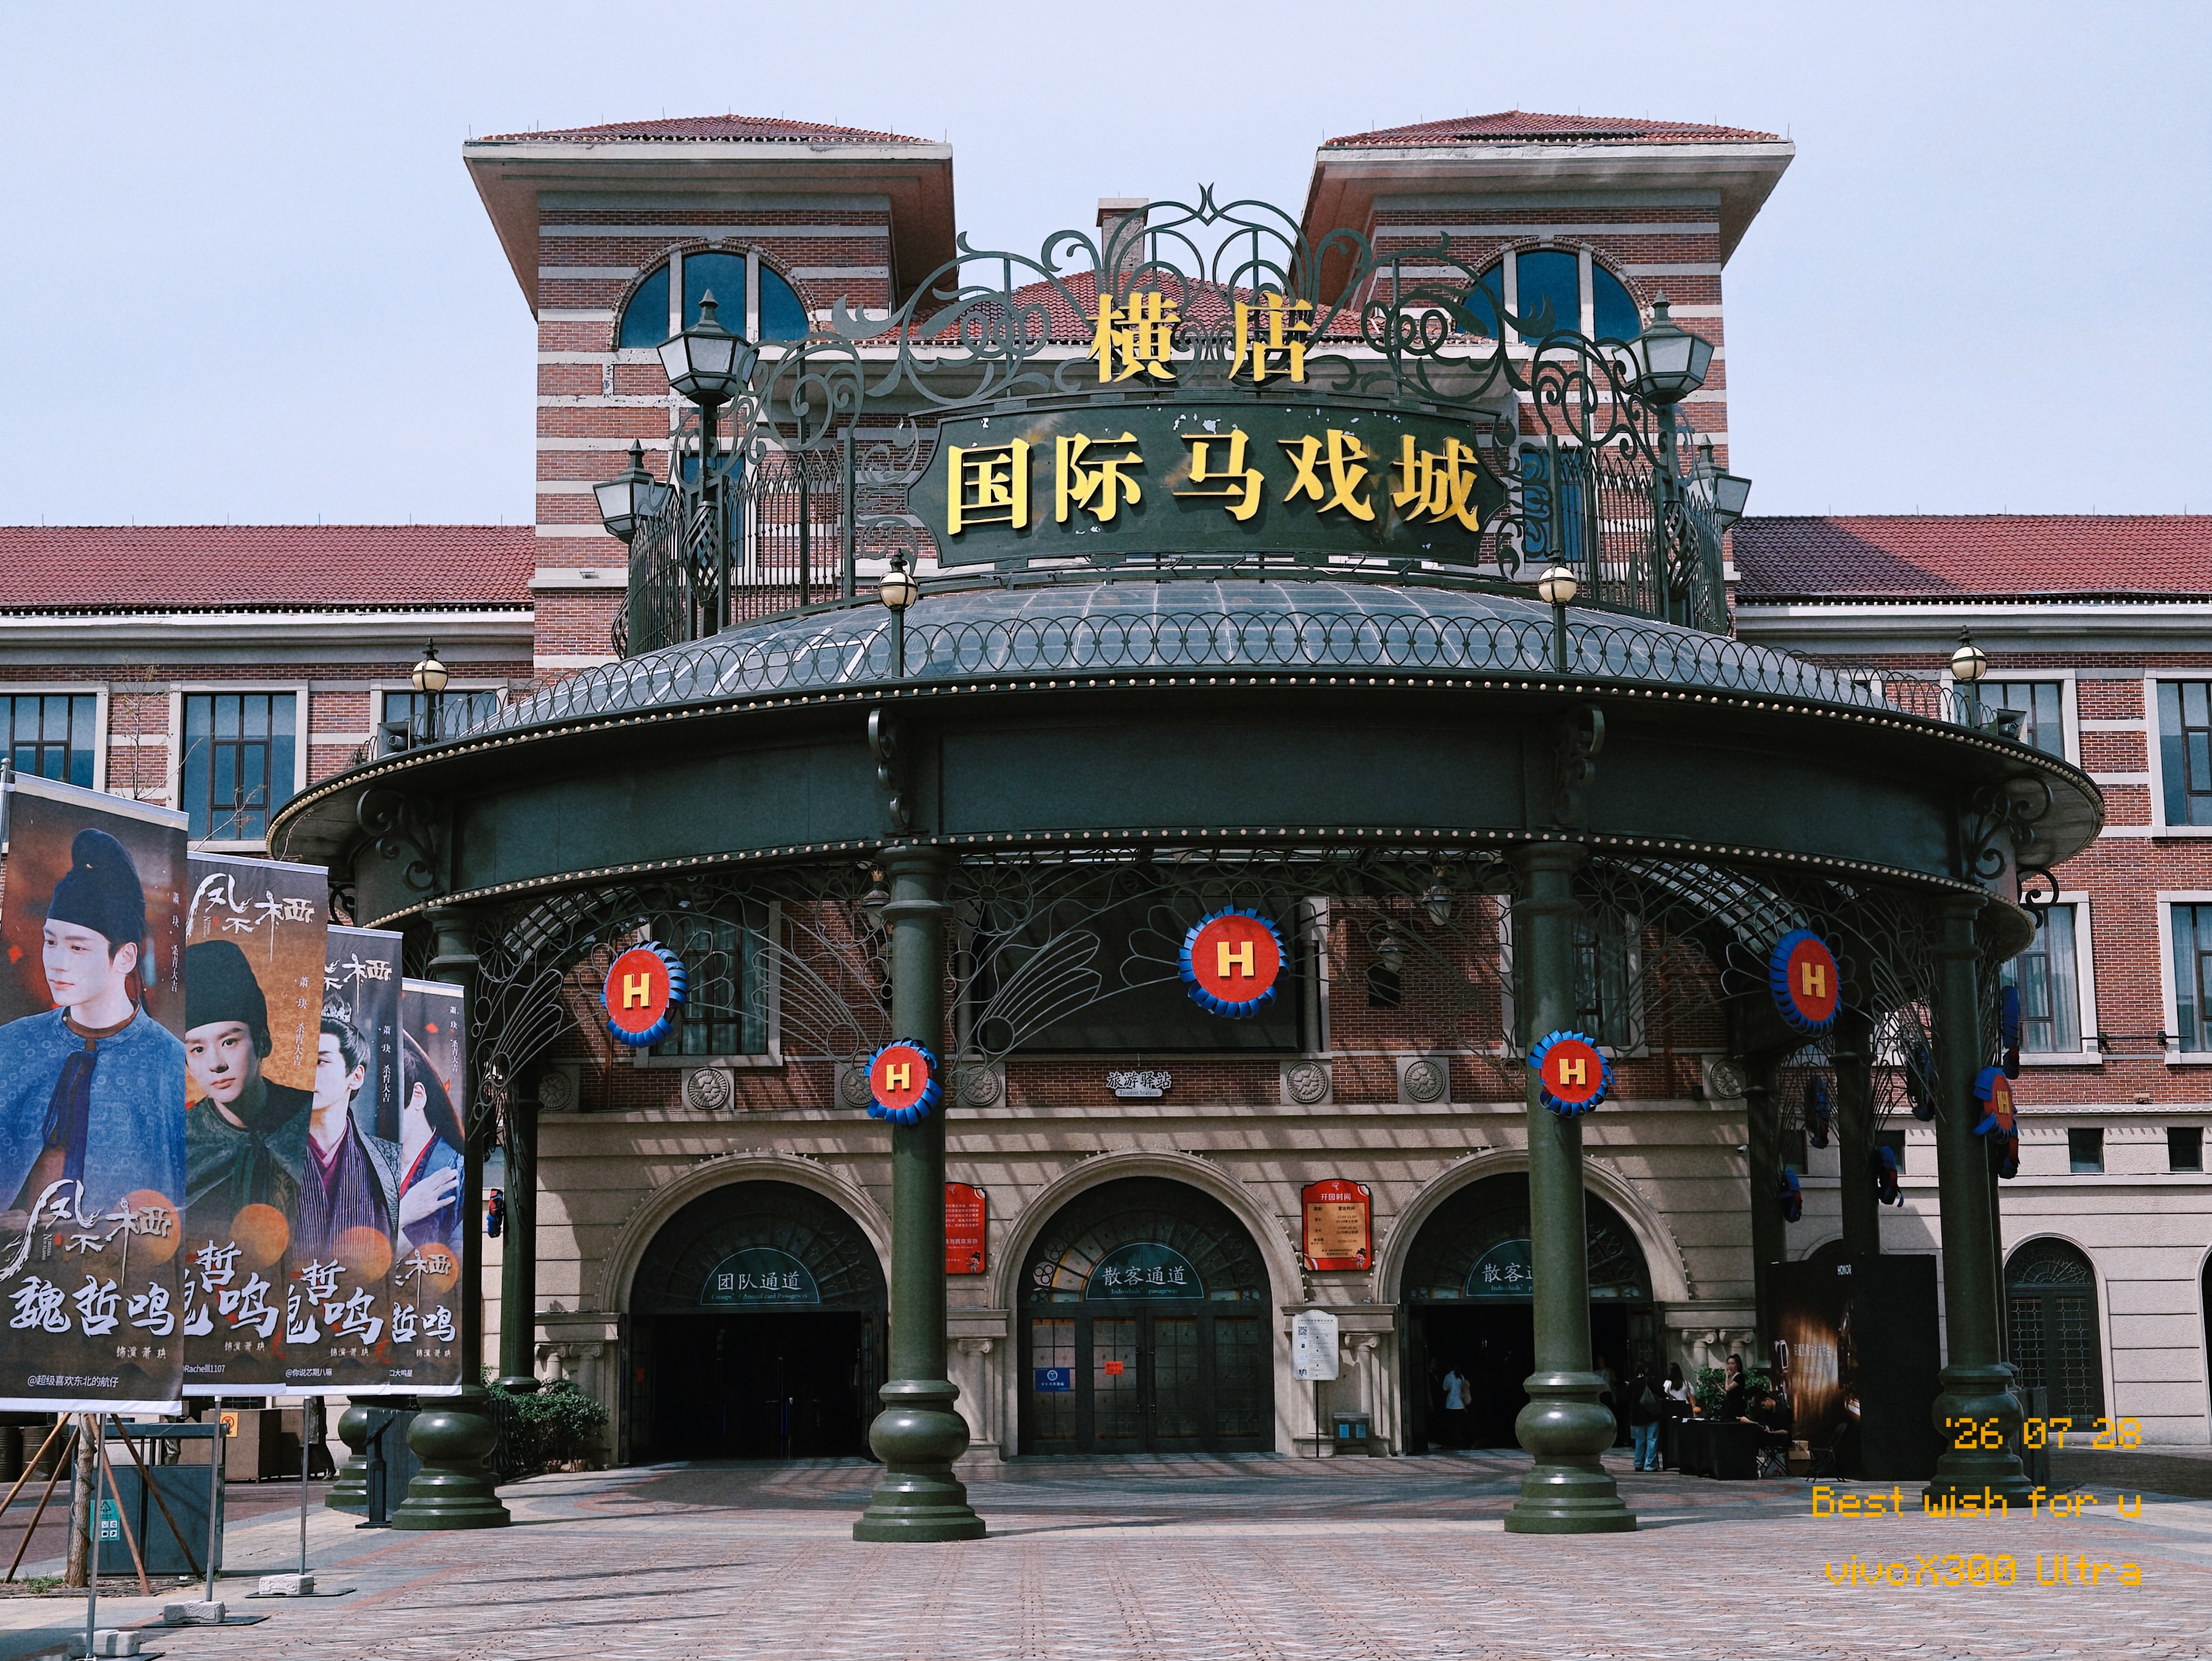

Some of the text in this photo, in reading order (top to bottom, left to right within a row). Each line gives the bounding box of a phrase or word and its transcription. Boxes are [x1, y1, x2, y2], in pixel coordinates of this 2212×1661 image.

[1087, 292, 1313, 383] 横店
[948, 429, 1479, 535] 国际马戏城
[1217, 941, 1254, 976] H
[623, 973, 650, 1009] H
[1802, 962, 1825, 998] H
[886, 1063, 910, 1091] H
[1107, 1071, 1171, 1089] 旅游驿站
[1559, 1059, 1586, 1085] H
[1997, 1091, 2010, 1114] H
[718, 1271, 802, 1291] 团队通道
[1102, 1265, 1187, 1286] 散客通道
[1837, 1264, 1851, 1275] HONOR
[8, 1274, 175, 1337] 魏哲鸣
[27, 1375, 119, 1388] @超级喜欢东北的航仔
